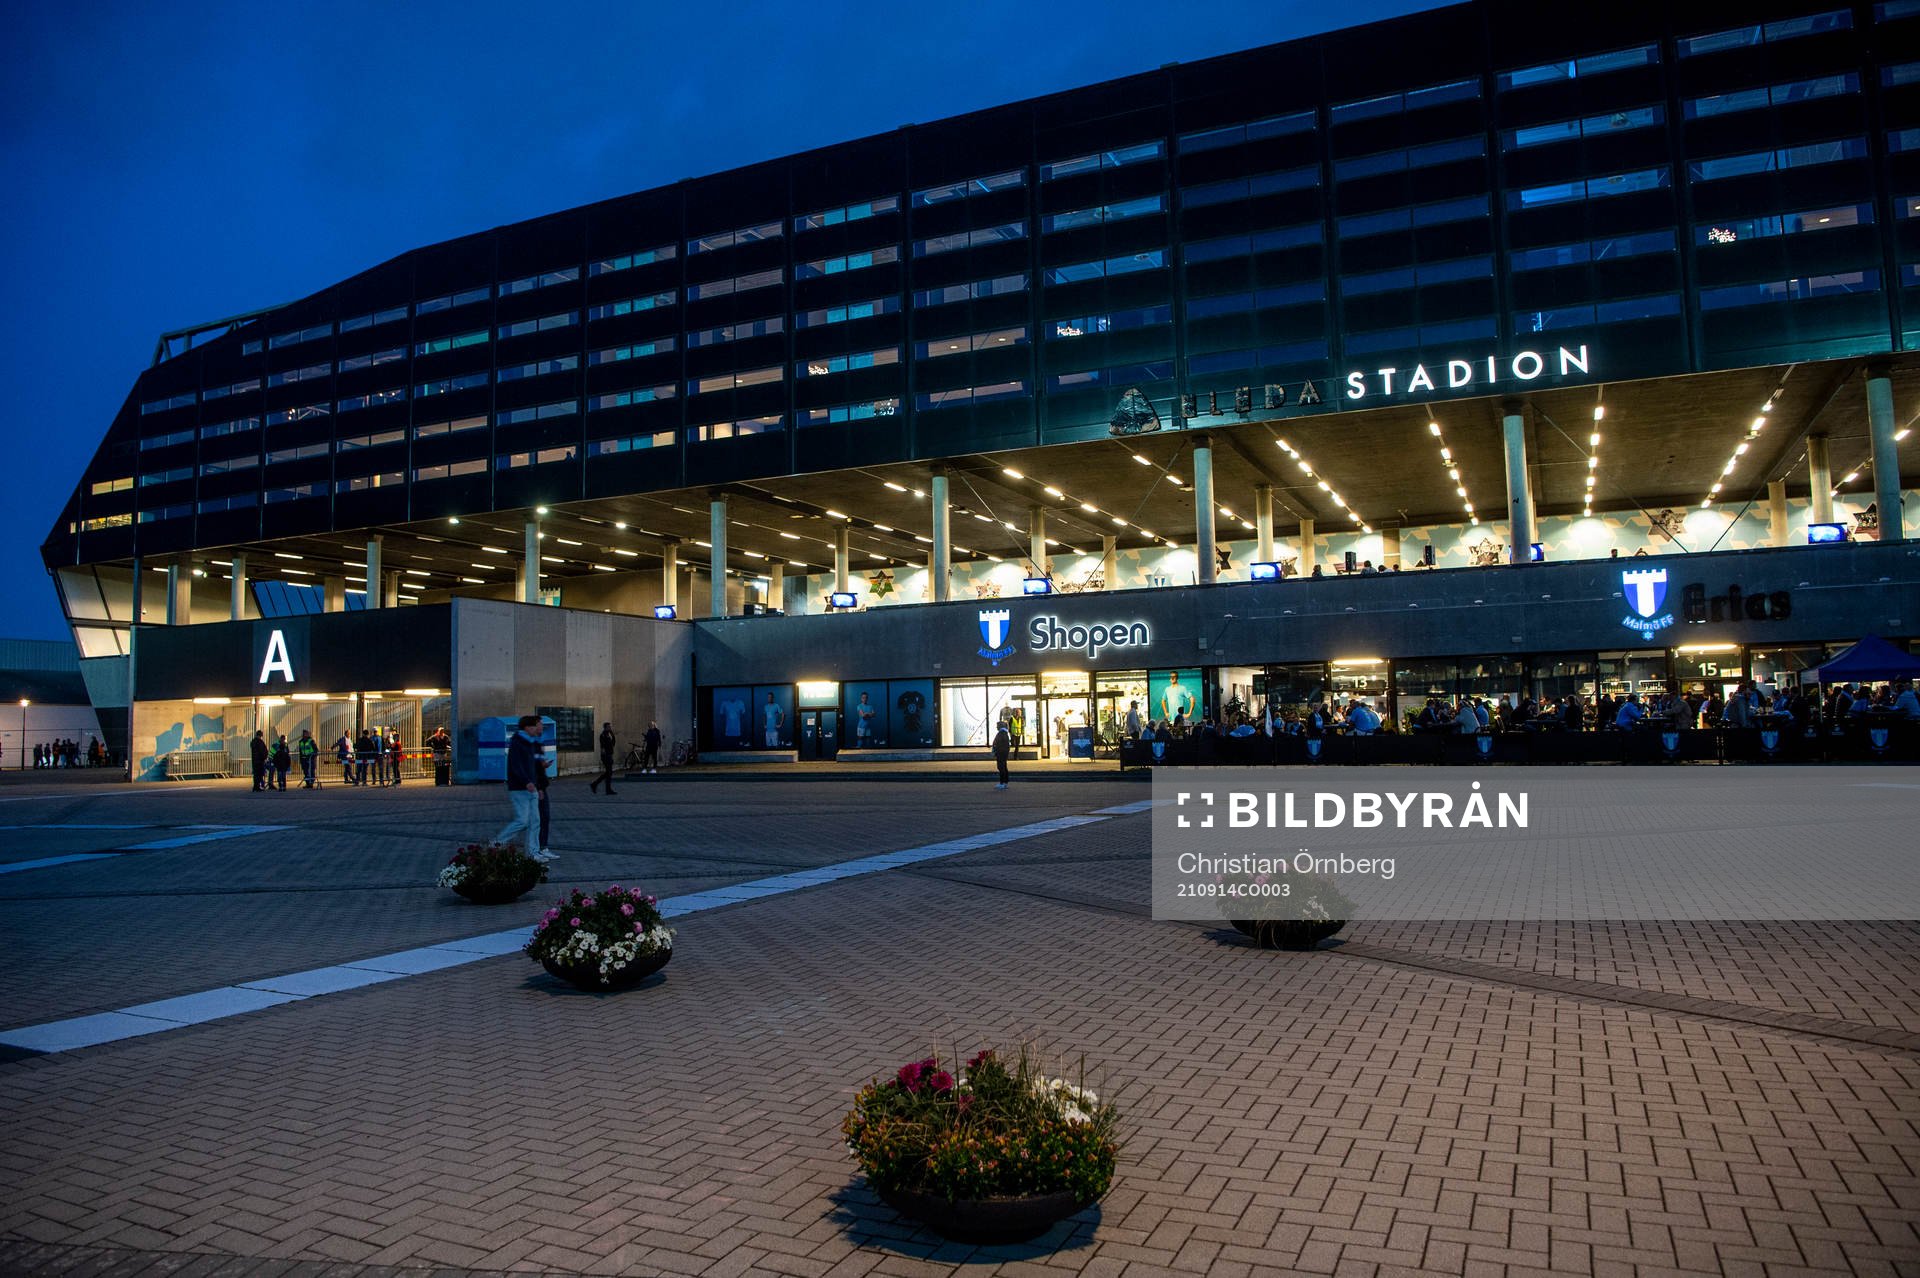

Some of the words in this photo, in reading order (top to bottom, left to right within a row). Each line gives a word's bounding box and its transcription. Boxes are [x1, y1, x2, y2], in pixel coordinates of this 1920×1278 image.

[1347, 344, 1590, 399] STADION
[1030, 615, 1151, 659] Shopen
[1621, 615, 1659, 631] Malmö
[1660, 613, 1675, 629] FF
[260, 630, 294, 683] A
[1698, 662, 1718, 677] 15
[1353, 676, 1368, 689] 13
